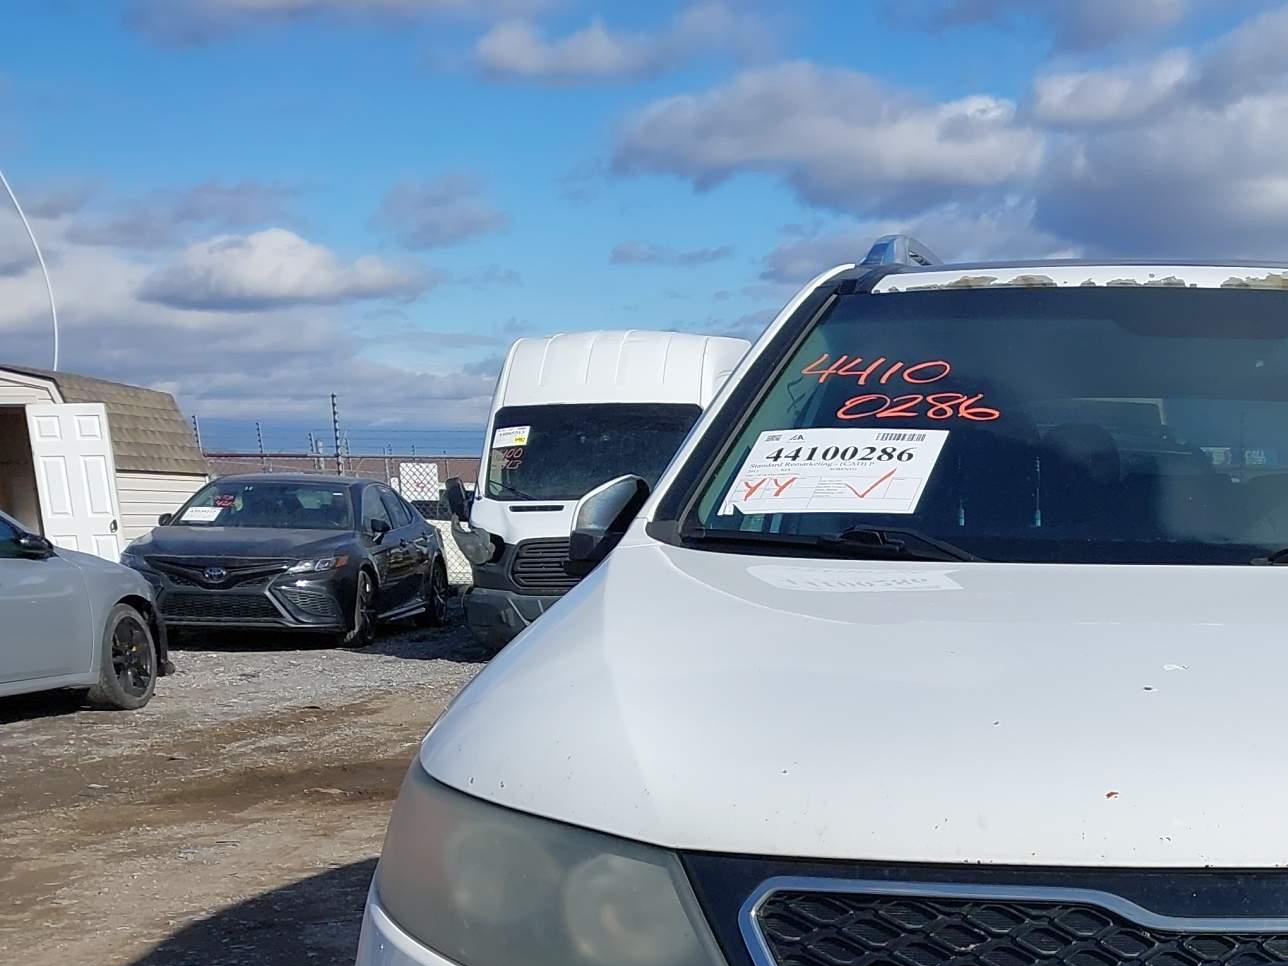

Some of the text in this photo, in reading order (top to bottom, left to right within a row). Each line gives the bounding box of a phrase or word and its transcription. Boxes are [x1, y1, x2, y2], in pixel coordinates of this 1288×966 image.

[801, 354, 950, 385] 4410
[837, 393, 1000, 420] 0286
[765, 446, 918, 463] 44100286
